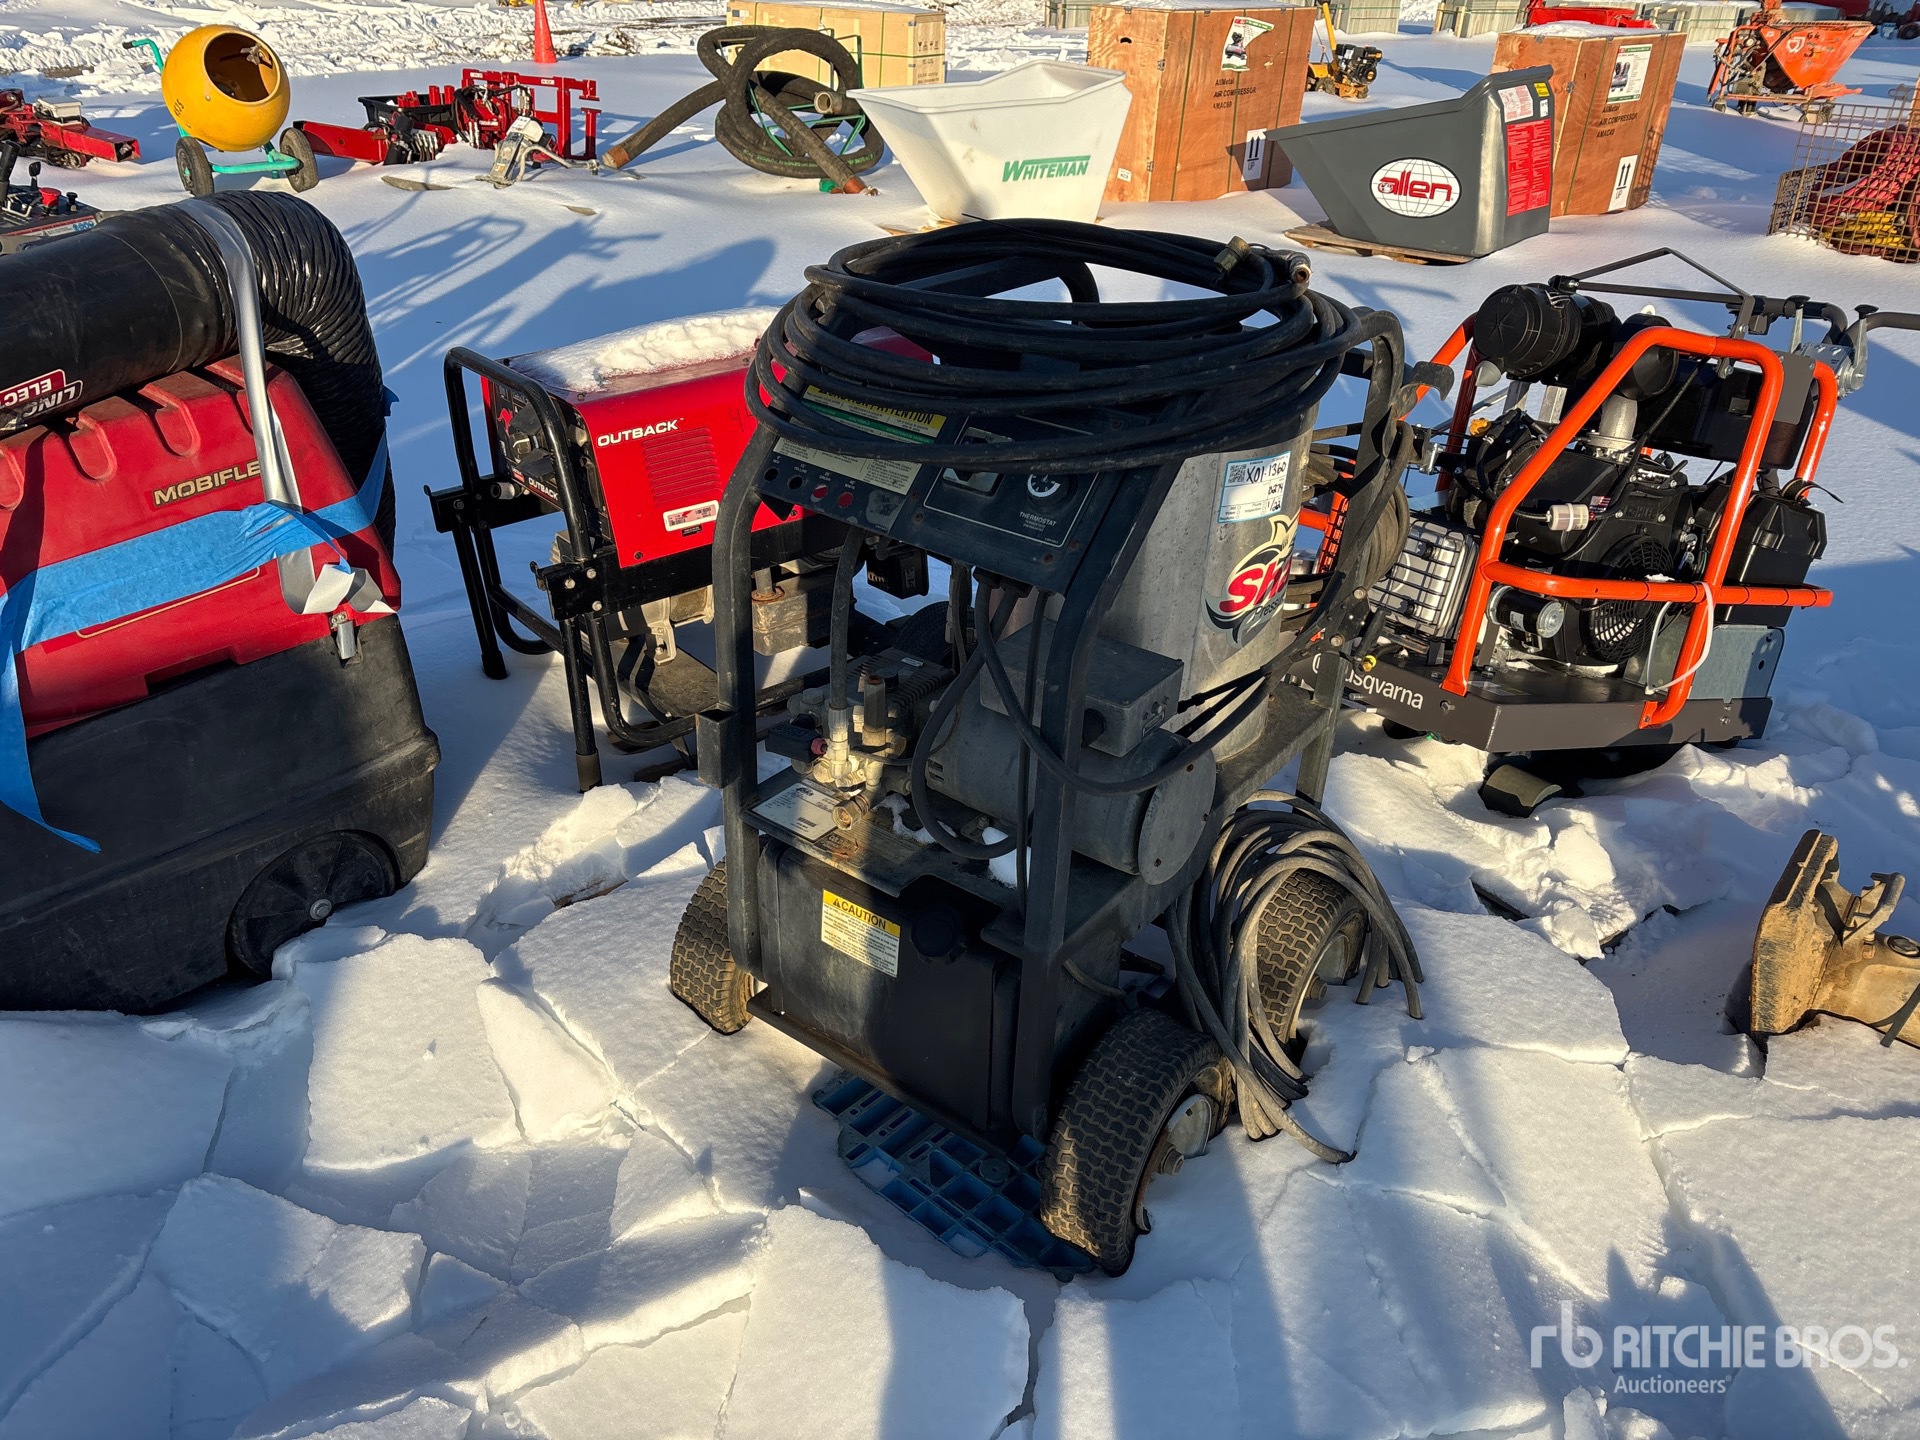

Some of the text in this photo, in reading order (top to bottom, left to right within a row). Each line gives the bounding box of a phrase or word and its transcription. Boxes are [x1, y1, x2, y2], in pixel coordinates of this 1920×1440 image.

[1002, 154, 1091, 182] WHITEMAN
[1377, 169, 1452, 202] allen
[0, 378, 52, 407] ELEC
[22, 385, 76, 418] LINC
[597, 419, 678, 447] OUTBACK
[153, 460, 261, 505] MOBIFLE
[1219, 558, 1292, 613] Sha
[1344, 666, 1424, 710] usqvarna
[841, 900, 887, 930] CAUTION
